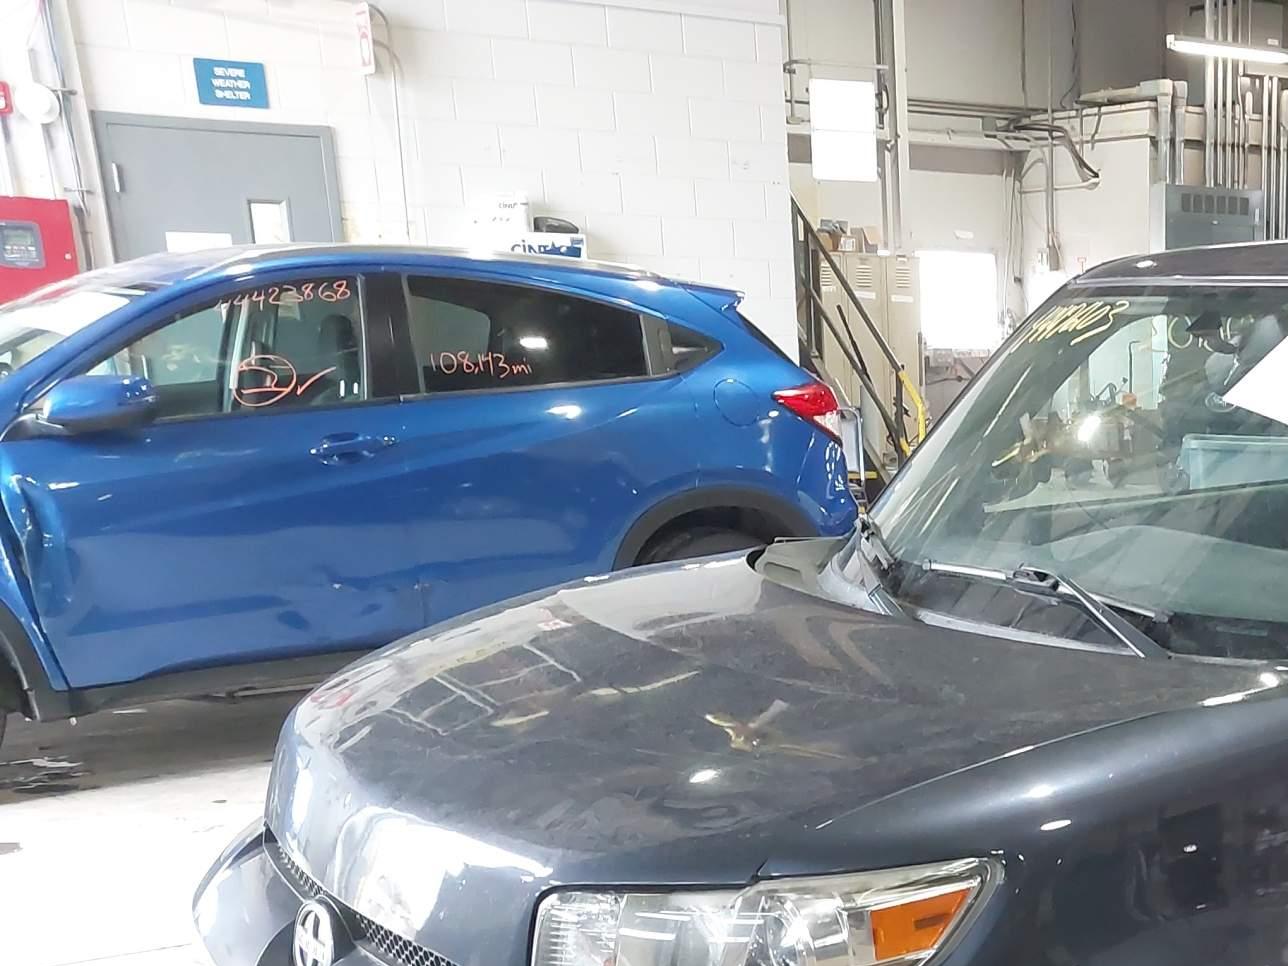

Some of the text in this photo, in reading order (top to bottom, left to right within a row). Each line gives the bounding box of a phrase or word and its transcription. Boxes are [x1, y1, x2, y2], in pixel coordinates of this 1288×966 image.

[213, 66, 246, 78] SEVERE
[211, 78, 251, 90] WEATHER
[214, 88, 252, 101] SHELTER
